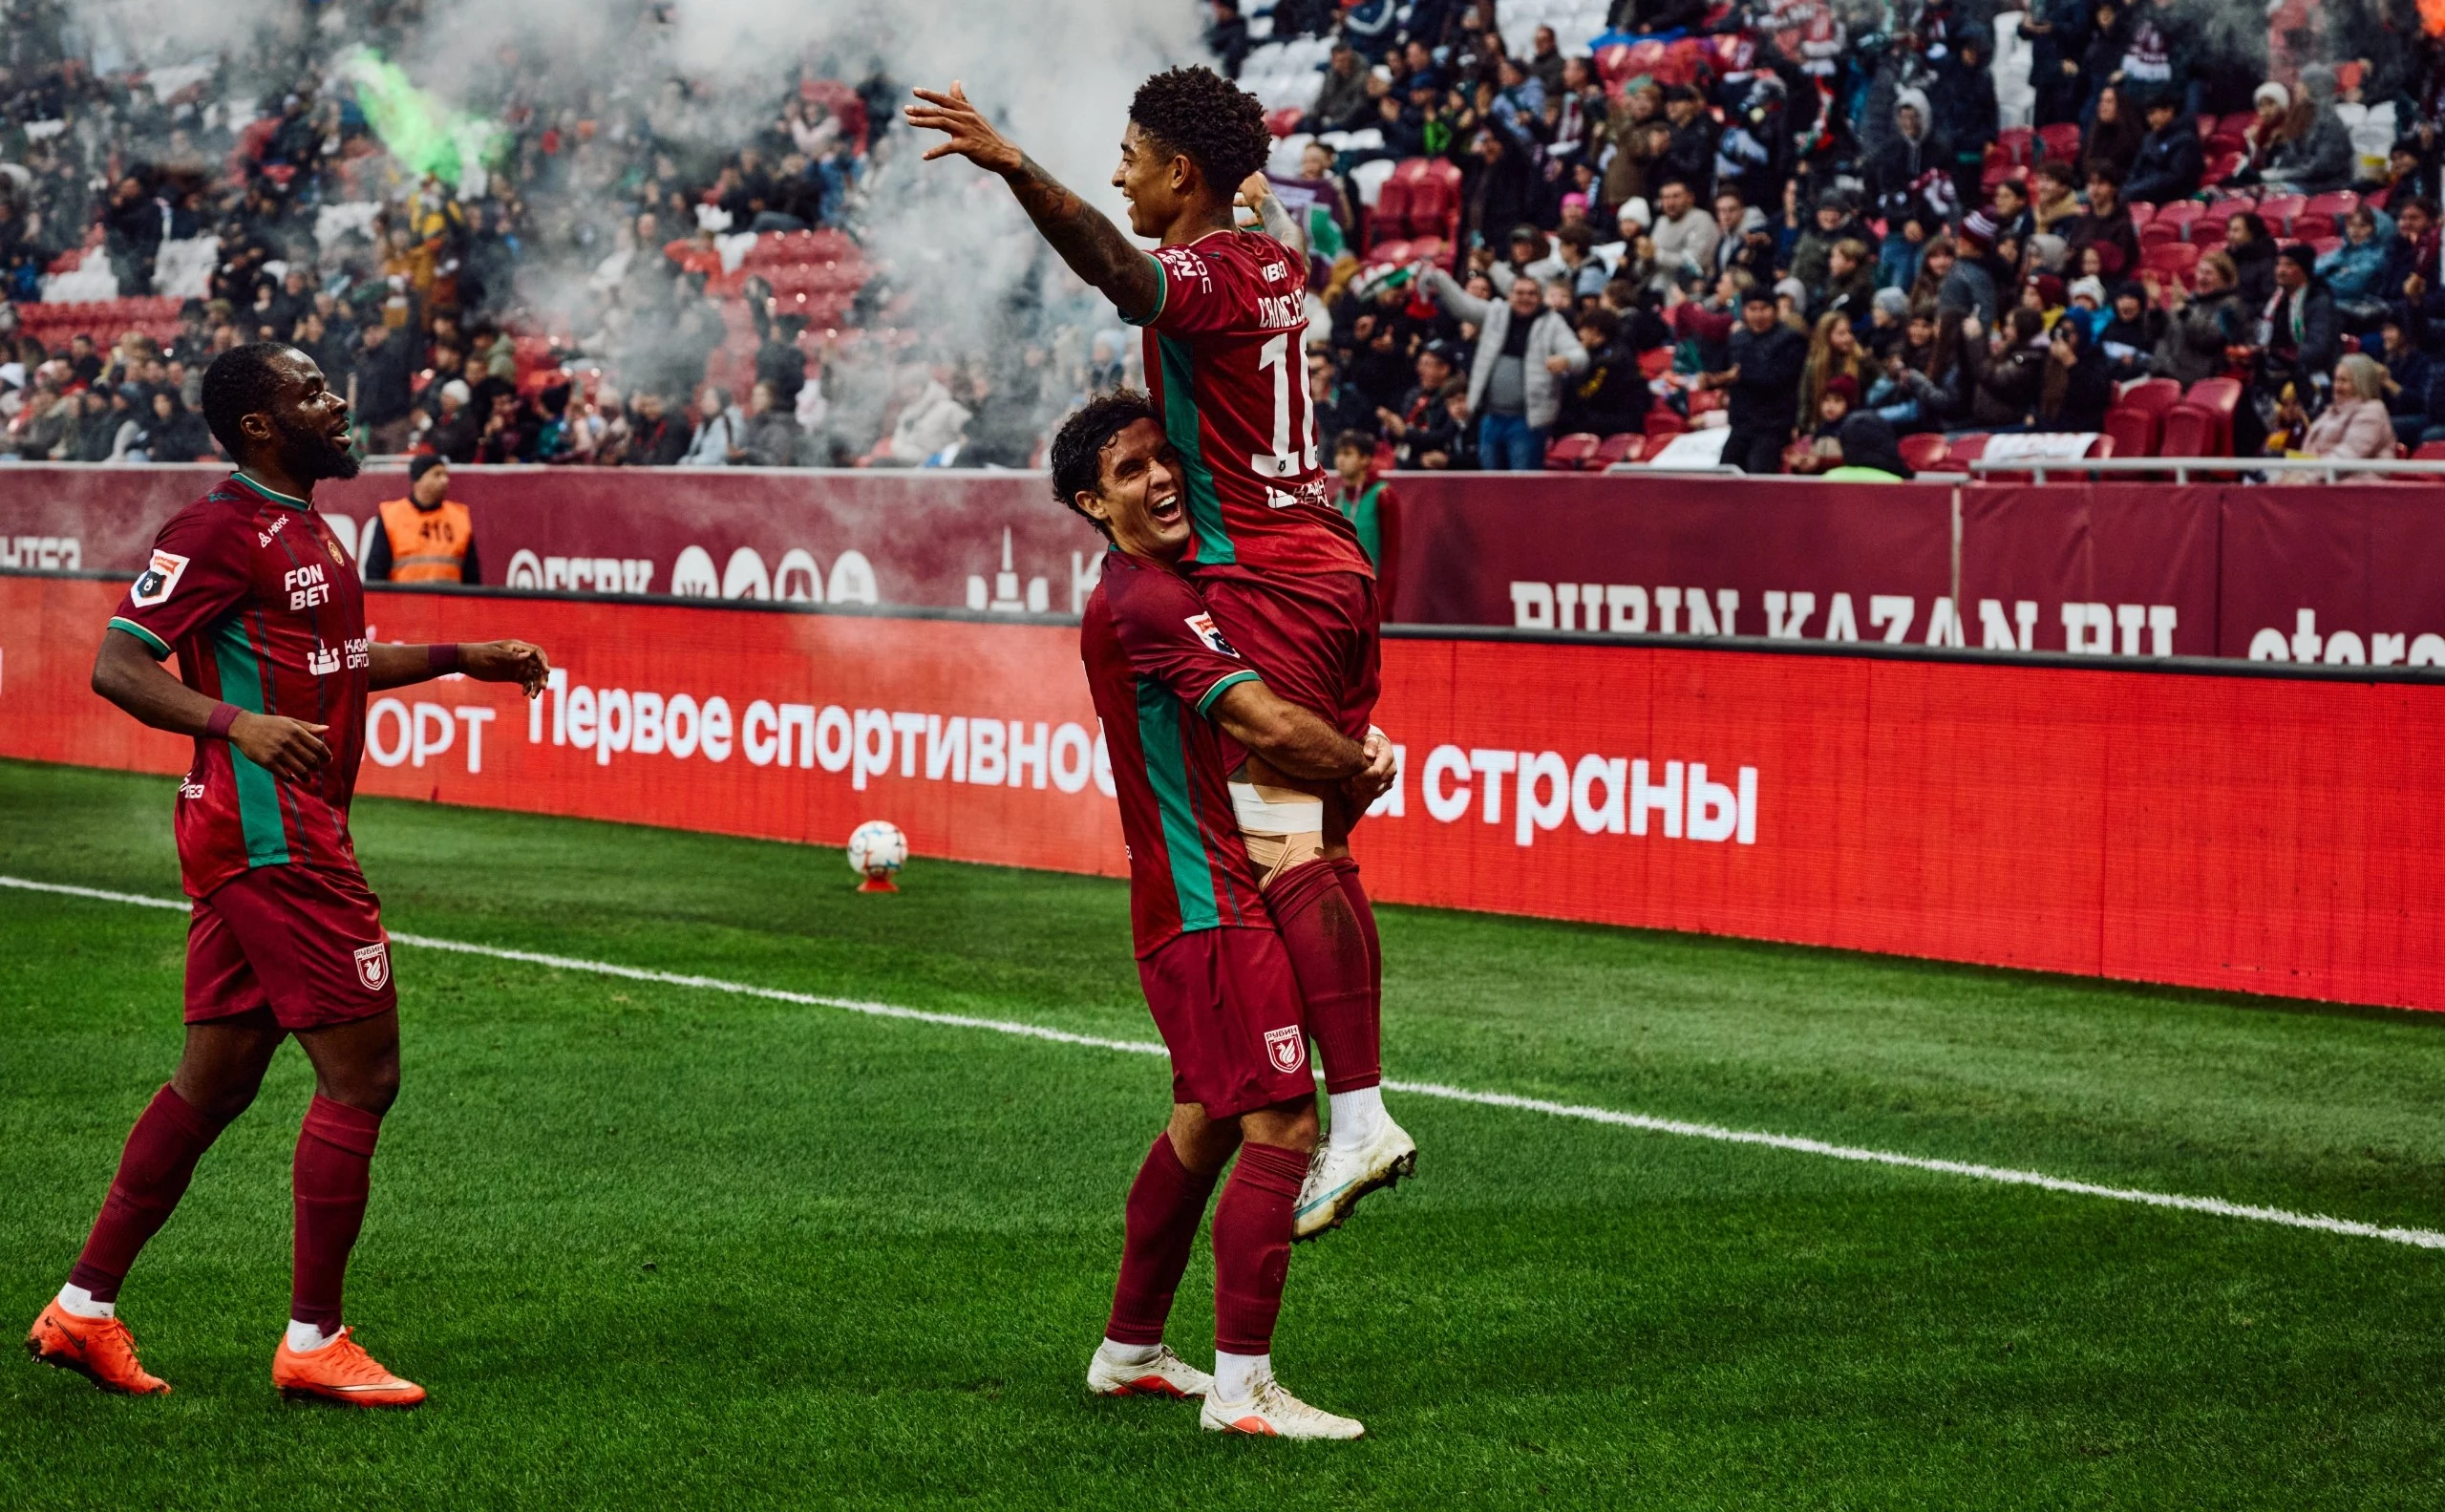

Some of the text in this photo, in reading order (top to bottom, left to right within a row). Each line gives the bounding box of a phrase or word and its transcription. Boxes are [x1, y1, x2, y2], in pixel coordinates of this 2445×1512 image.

[285, 564, 324, 591] FON
[290, 584, 330, 611] BET
[363, 697, 497, 774] ОРТ
[529, 667, 734, 765] Первое
[1422, 744, 1758, 847] страны
[355, 945, 383, 957] РУБИН
[1265, 1027, 1298, 1041] РУБИН
